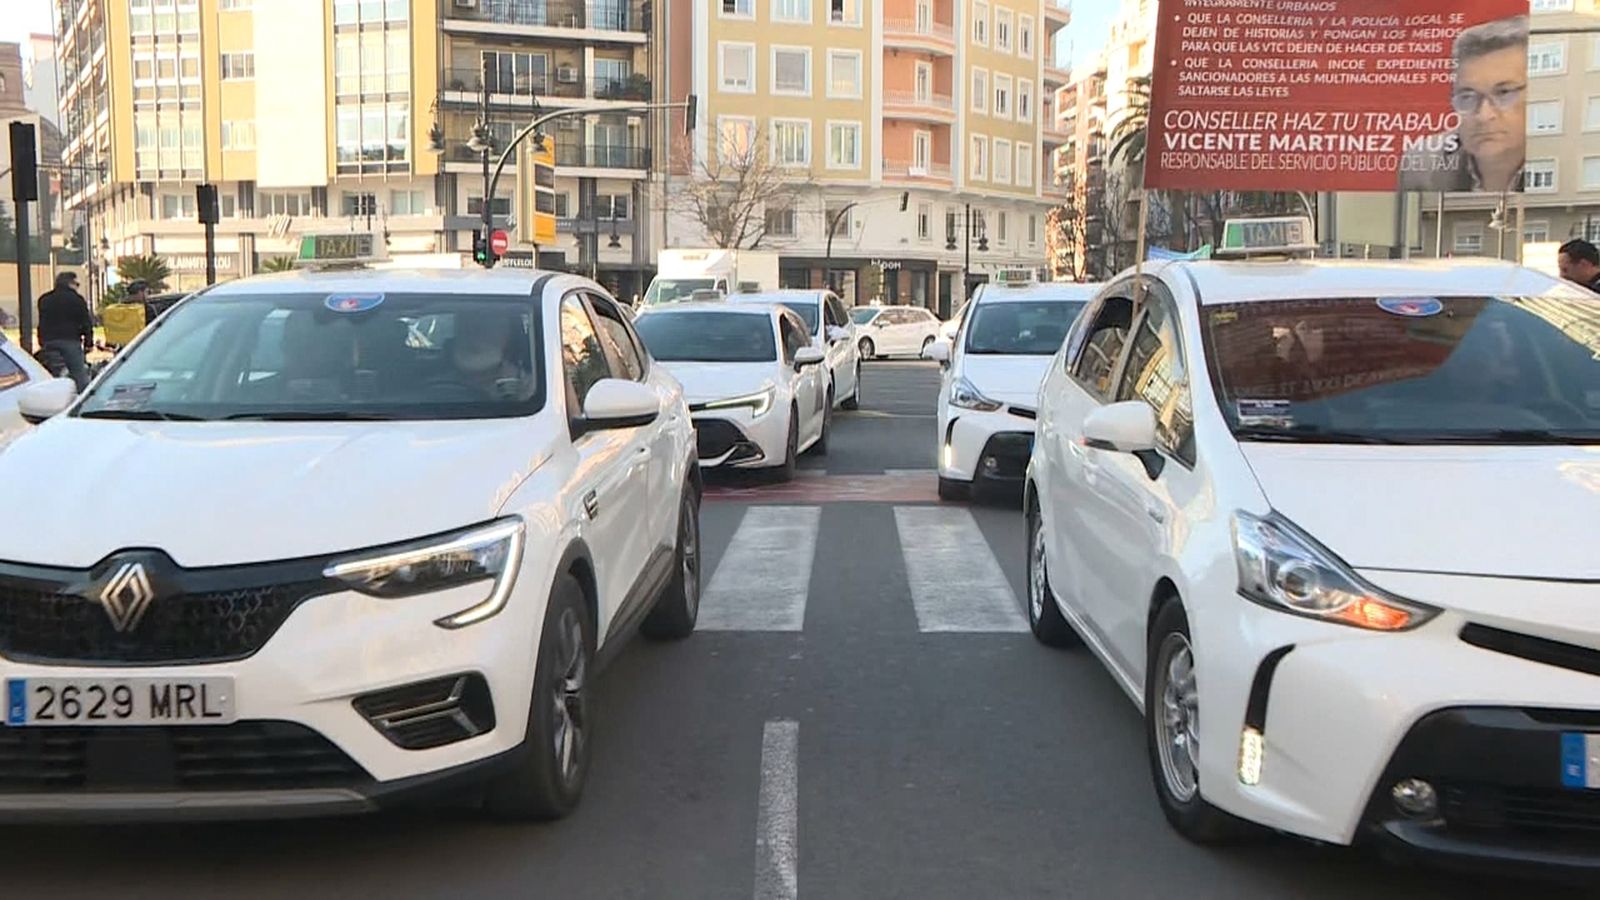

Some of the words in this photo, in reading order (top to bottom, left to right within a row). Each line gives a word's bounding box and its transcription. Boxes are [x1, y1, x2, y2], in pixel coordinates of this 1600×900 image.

[1276, 1, 1336, 12] URBANOS
[1187, 13, 1211, 24] QUE
[1217, 14, 1231, 23] LA
[1236, 14, 1313, 26] CONSELLERIA
[1319, 17, 1328, 26] Y
[1332, 17, 1346, 26] LA
[1352, 16, 1399, 26] POLICÍA
[1405, 14, 1442, 25] LOCAL
[1448, 13, 1465, 24] SE
[1182, 27, 1217, 38] DEJEN
[1223, 28, 1239, 38] DE
[1245, 28, 1304, 39] HISTORIAS
[1310, 30, 1317, 39] Y
[1324, 30, 1377, 40] PONGAN
[1383, 30, 1406, 39] LOS
[1412, 28, 1463, 38] MEDIOS
[1181, 41, 1210, 52] PARA
[1212, 41, 1237, 53] QUE
[1239, 42, 1261, 52] LAS
[1262, 42, 1284, 52] VTC
[1287, 43, 1322, 53] DEJEN
[1326, 43, 1342, 53] DE
[1345, 43, 1385, 53] HACER
[1388, 43, 1405, 53] DE
[1408, 42, 1443, 53] TAXIS
[1184, 58, 1209, 69] QUE
[1218, 58, 1232, 68] LA
[1242, 58, 1318, 69] CONSELLERIA
[1328, 59, 1365, 70] INCOE
[1376, 58, 1459, 70] EXPEDIENTES
[1179, 71, 1276, 83] SANCIONADORES
[1278, 73, 1287, 83] A
[1290, 73, 1310, 83] LAS
[1314, 73, 1427, 84] MULTINACIONALES
[1431, 73, 1457, 83] POR
[1178, 85, 1231, 96] SALTARSE
[1233, 86, 1254, 96] LAS
[1256, 86, 1289, 97] LEYES
[1164, 110, 1277, 130] CONSELLER
[1283, 112, 1326, 131] HAZ
[1331, 112, 1359, 131] TU
[1363, 112, 1462, 131] TRABAJO
[1164, 132, 1262, 150] VICENTE
[1269, 133, 1395, 152] MARTINEZ
[1402, 134, 1458, 152] MUS
[1161, 152, 1249, 169] RESPONSABLE
[1251, 153, 1276, 170] DEL
[1279, 153, 1337, 171] SERVICIO
[1340, 151, 1398, 171] PÚBLICO
[1400, 155, 1428, 171] DEL
[1430, 155, 1459, 170] TAXI
[1246, 224, 1284, 243] TAXI
[320, 238, 357, 256] TAXI
[34, 684, 134, 719] 2629
[149, 684, 223, 718] MRL
